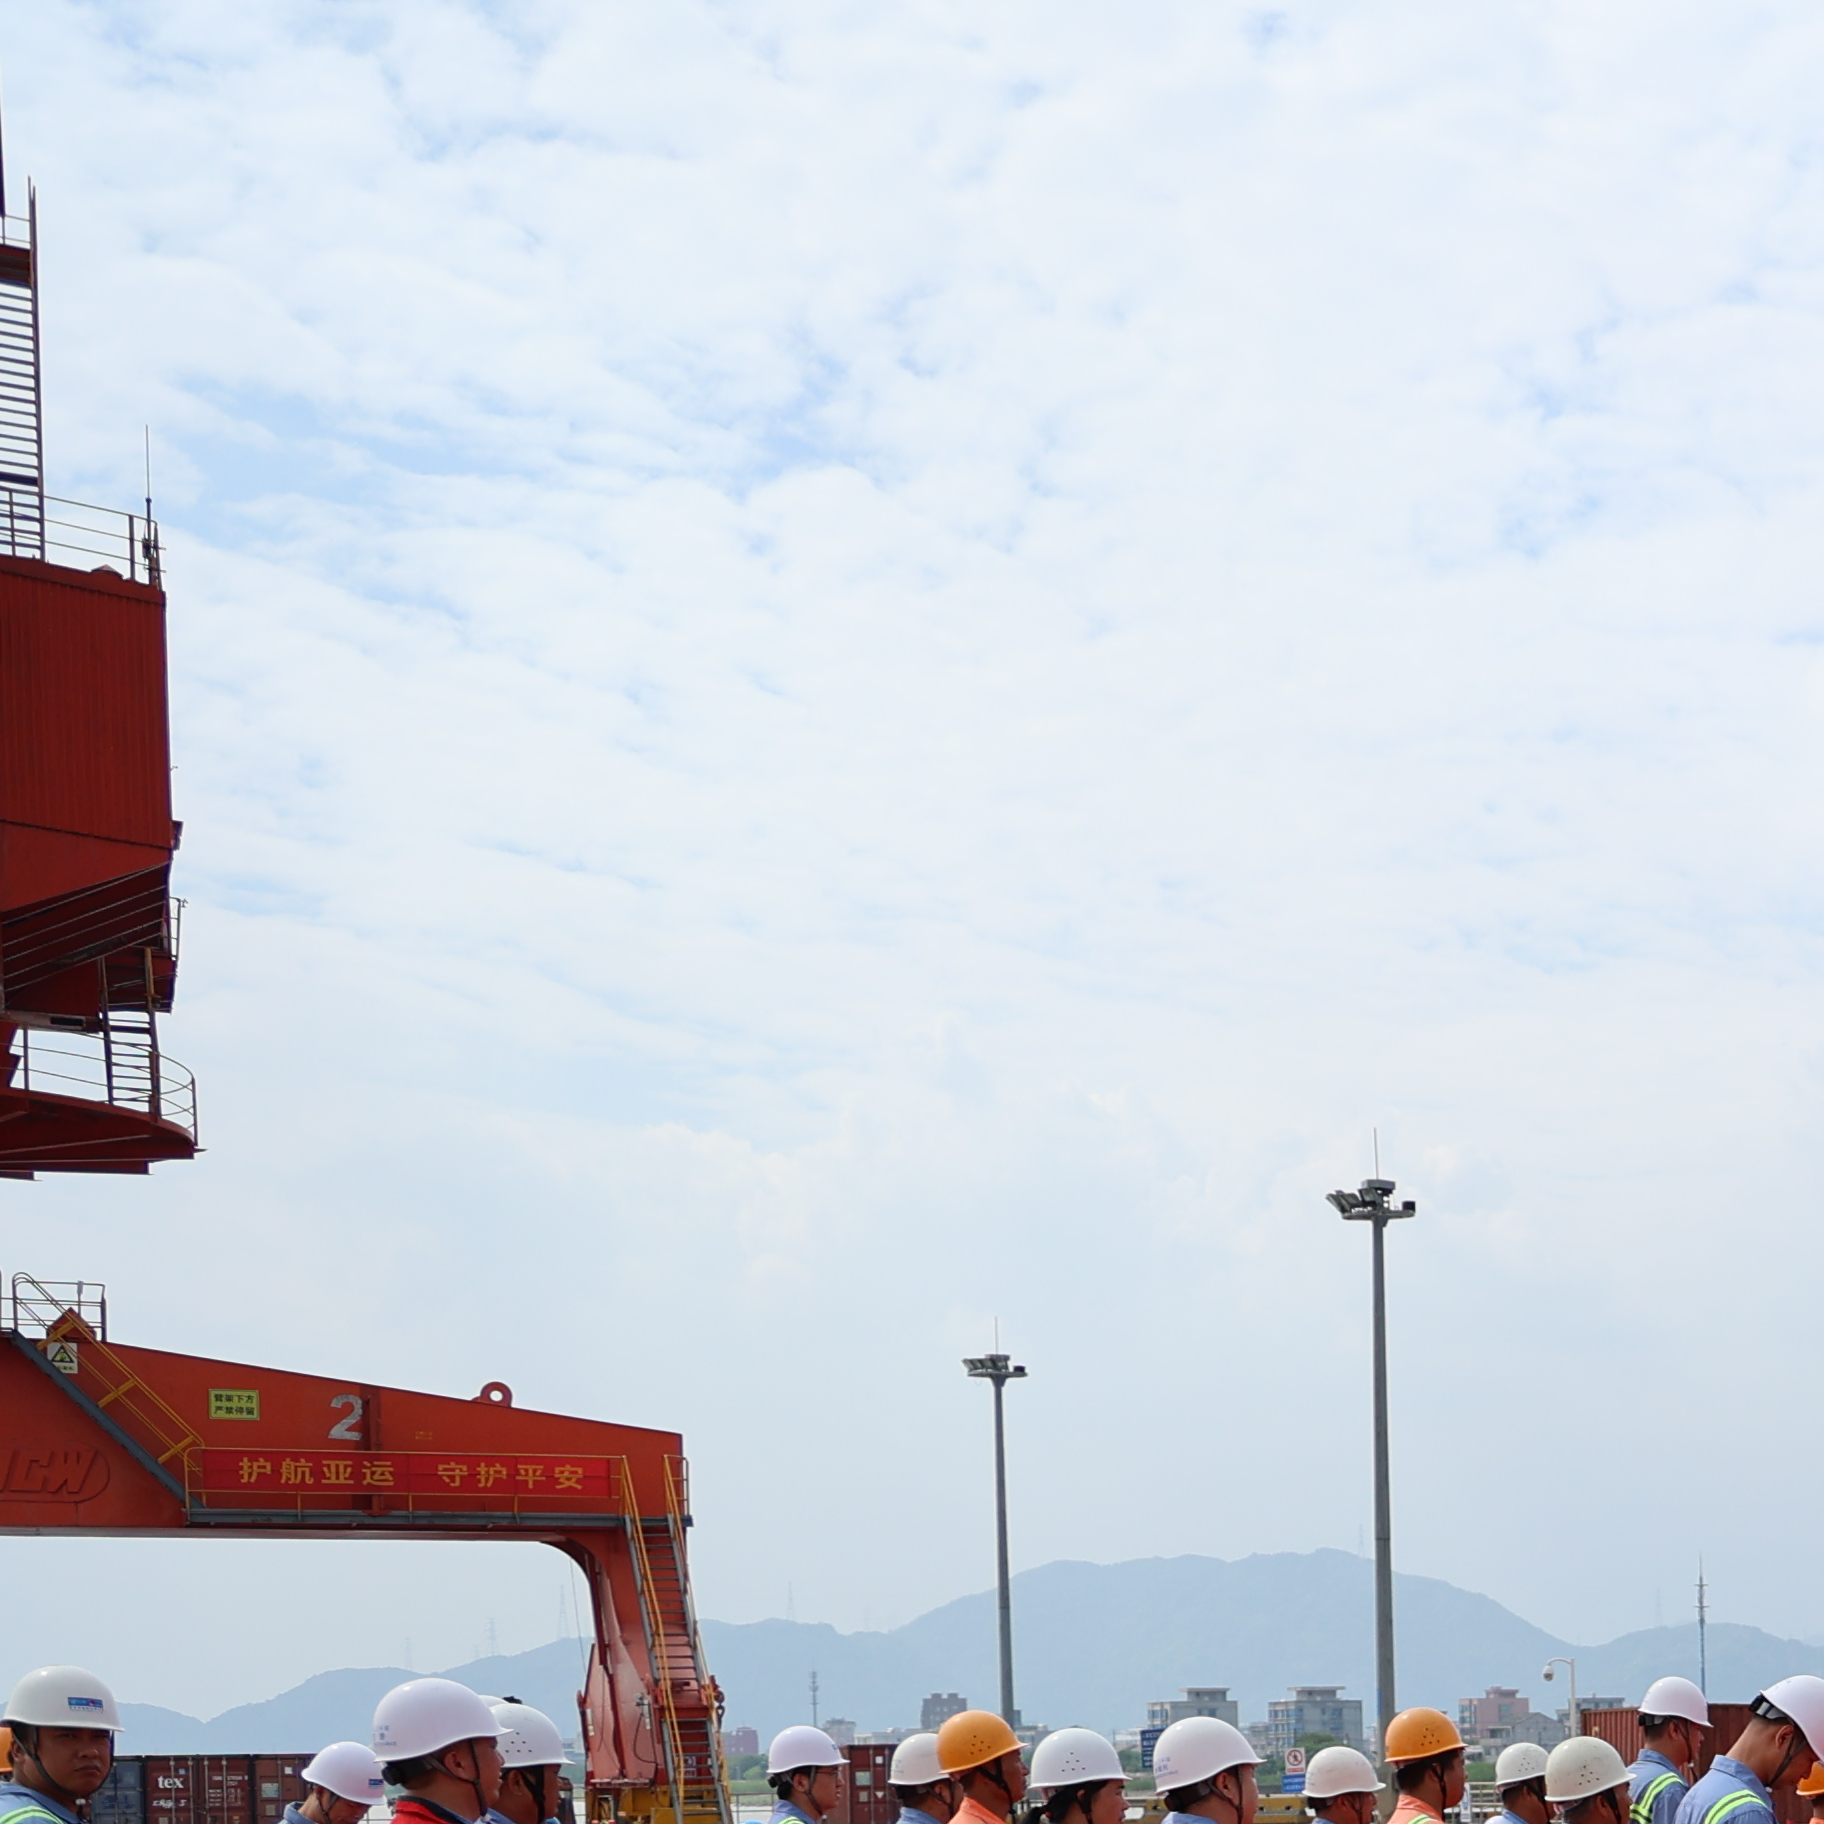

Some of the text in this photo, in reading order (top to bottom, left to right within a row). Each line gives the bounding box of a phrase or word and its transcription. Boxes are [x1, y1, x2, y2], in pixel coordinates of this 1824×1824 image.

[327, 1394, 363, 1441] 2
[239, 1457, 584, 1490] 护航亚运 守护平安
[157, 1775, 185, 1789] tex
